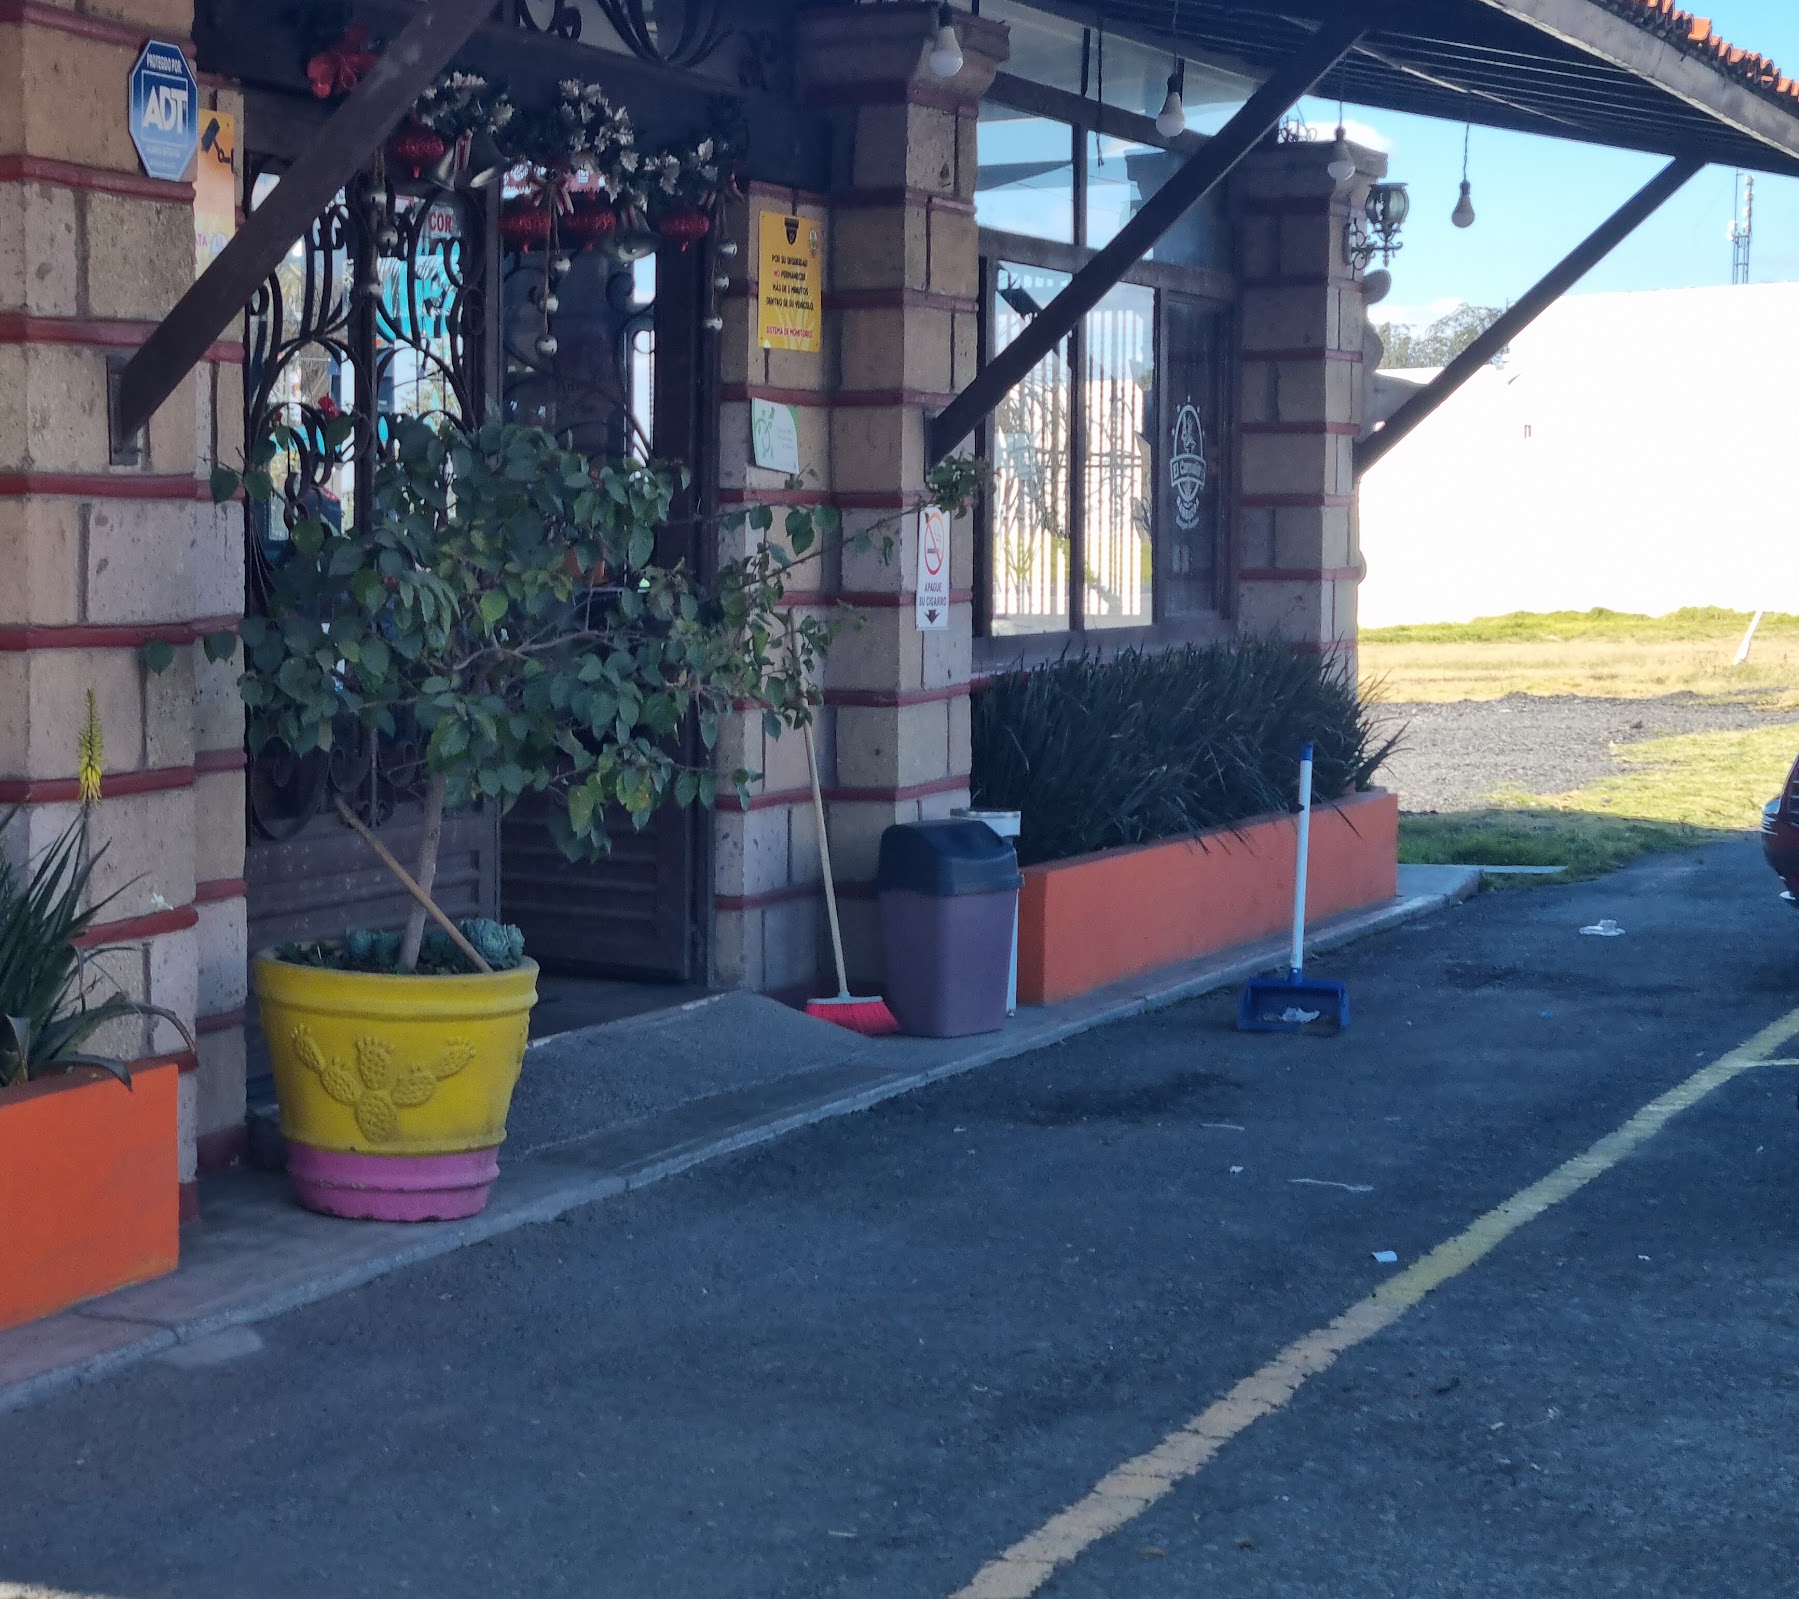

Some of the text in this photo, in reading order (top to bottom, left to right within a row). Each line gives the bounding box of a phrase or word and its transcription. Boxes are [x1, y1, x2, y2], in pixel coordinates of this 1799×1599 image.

[143, 84, 188, 135] ADT
[766, 325, 783, 335] SISTEMA
[924, 582, 942, 592] APAGUE
[919, 596, 947, 607] SU CIGARRO
